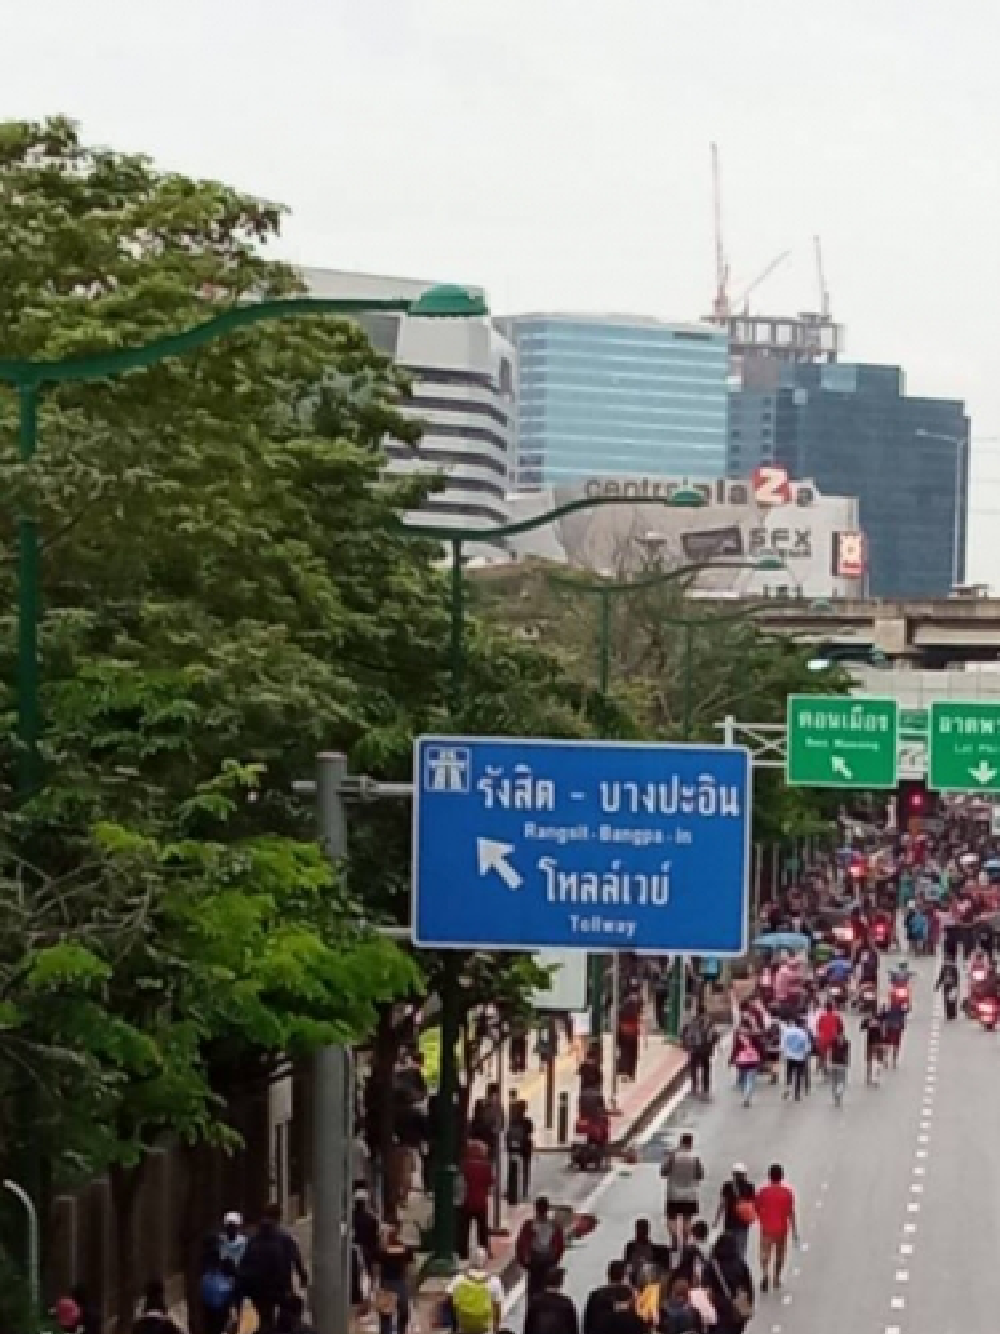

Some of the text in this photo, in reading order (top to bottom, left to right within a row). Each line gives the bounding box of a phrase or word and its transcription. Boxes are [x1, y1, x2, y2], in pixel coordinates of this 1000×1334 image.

[476, 764, 556, 810] รังสิต
[599, 772, 740, 817] บางปะอิน
[537, 855, 671, 905] โทลล์เวย์
[570, 914, 637, 939] Tollway
